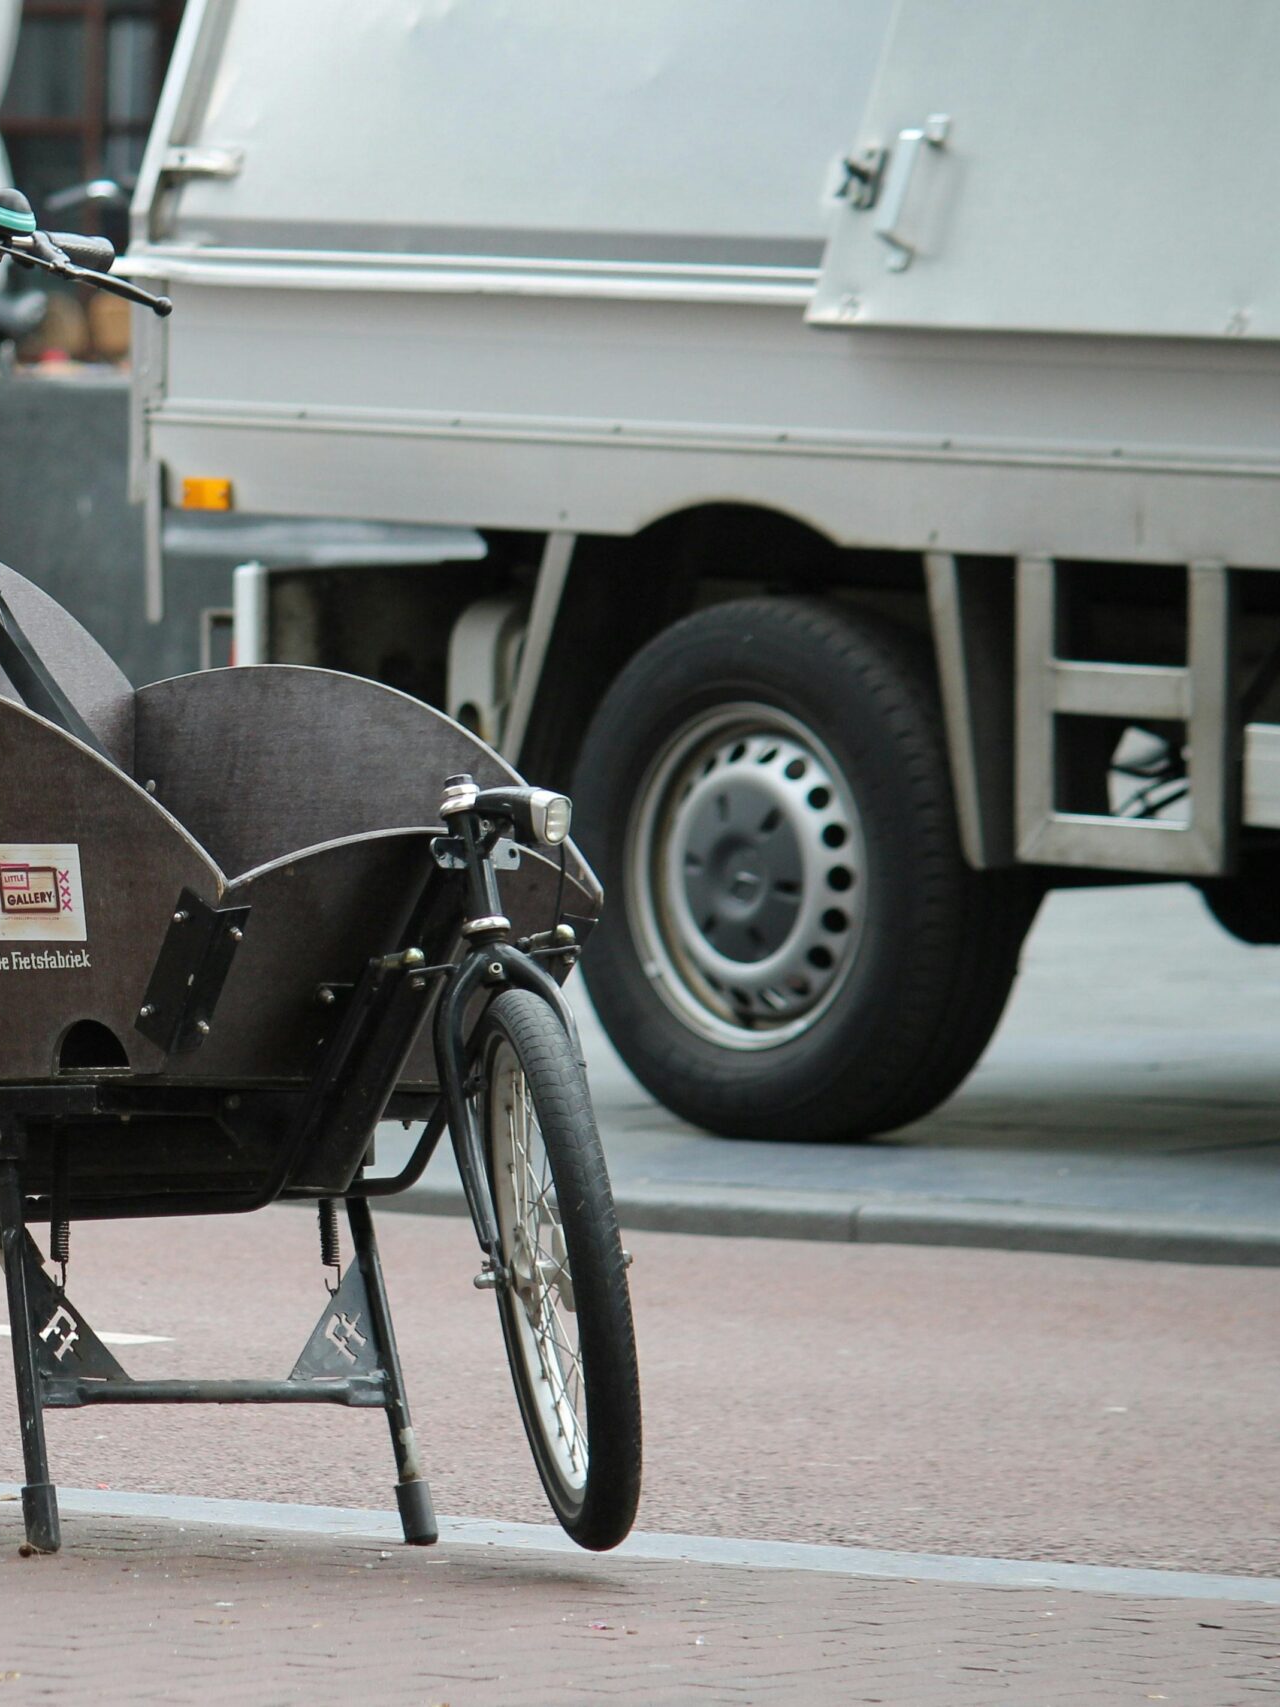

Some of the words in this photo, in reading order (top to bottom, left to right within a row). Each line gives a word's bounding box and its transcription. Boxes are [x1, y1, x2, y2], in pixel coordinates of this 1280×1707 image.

[4, 874, 25, 883] LITTLE
[7, 890, 53, 906] GALLERY
[11, 948, 92, 970] Fietsfabriek
